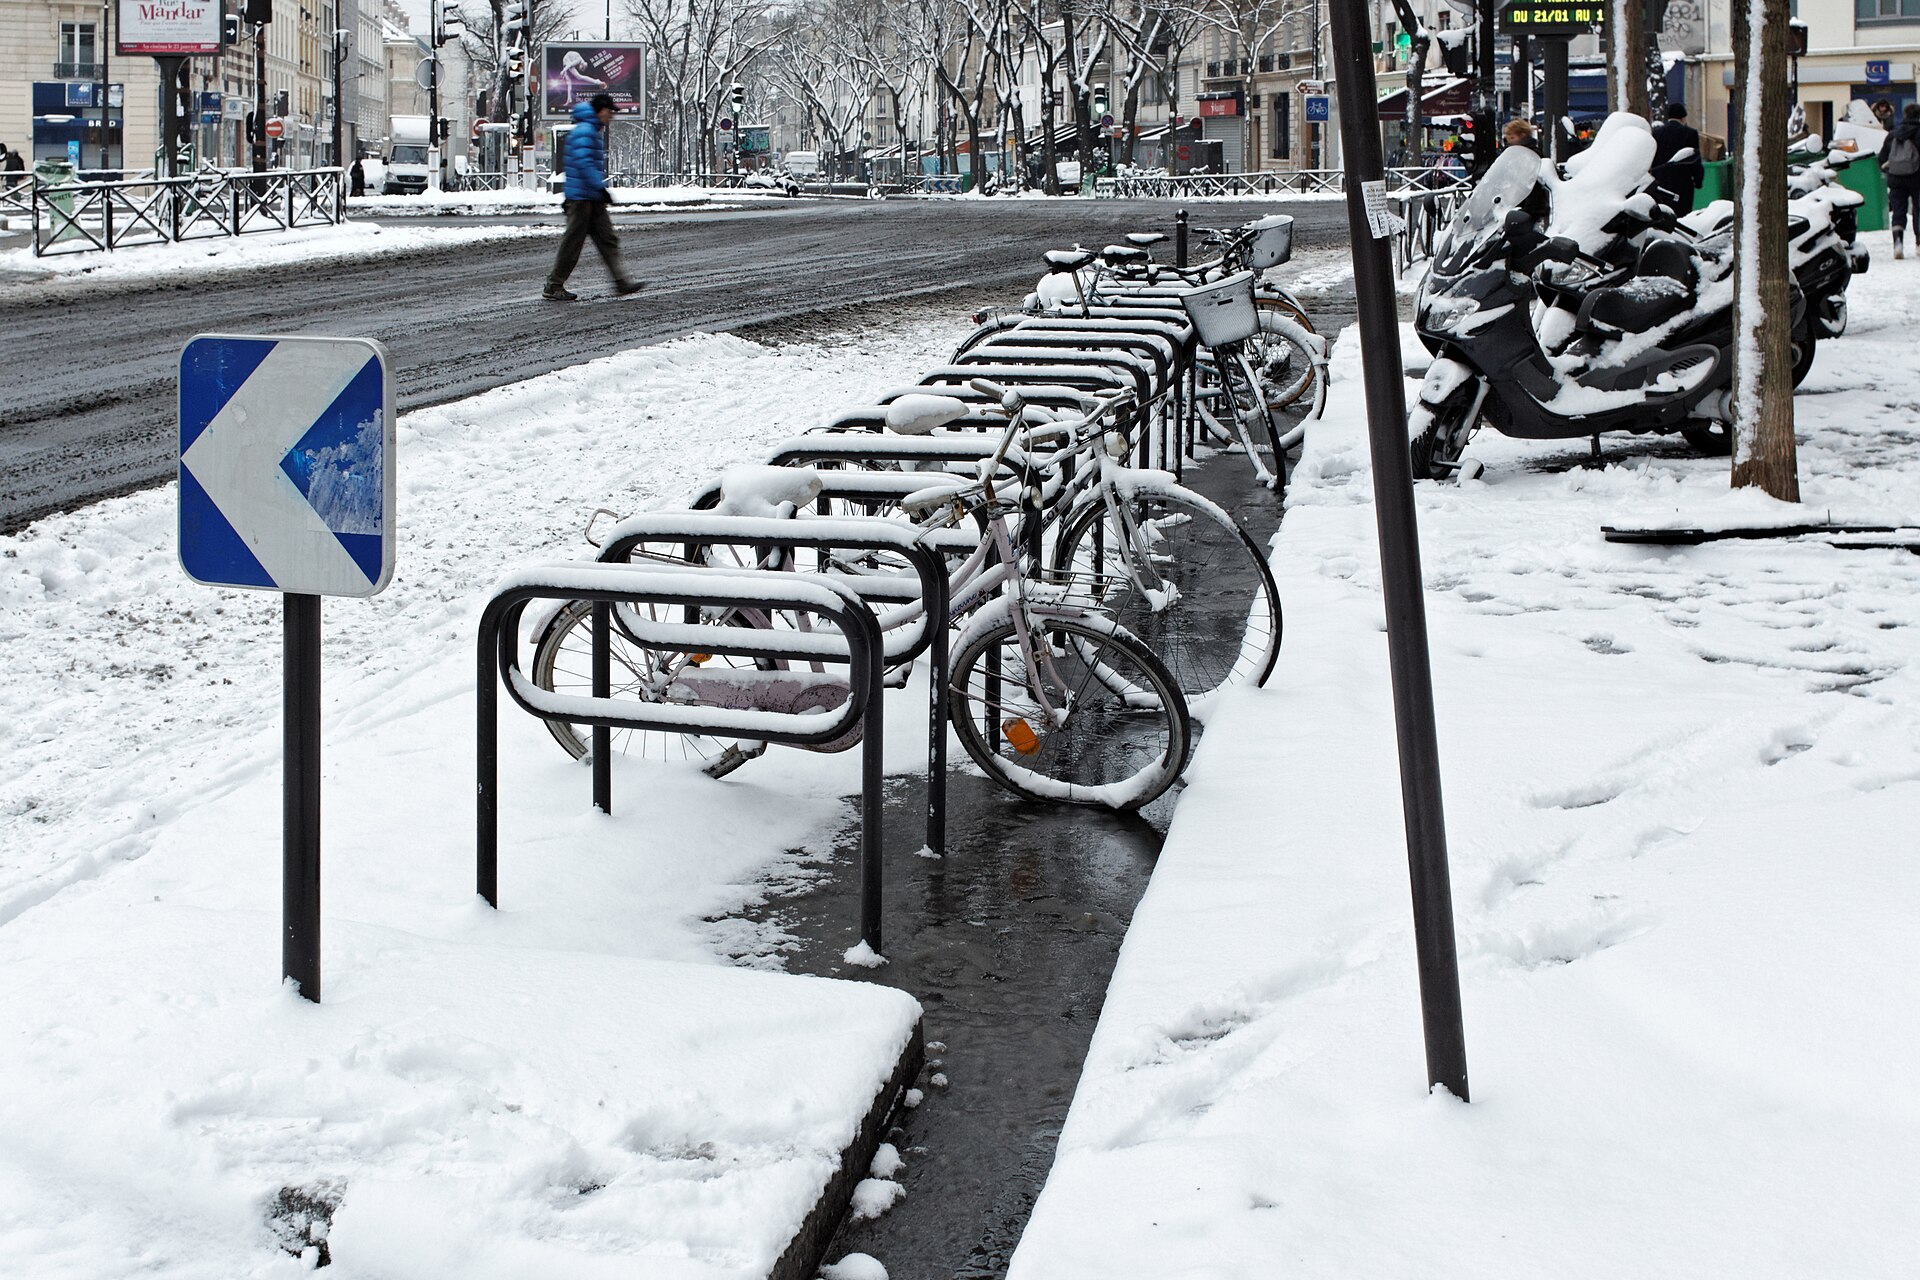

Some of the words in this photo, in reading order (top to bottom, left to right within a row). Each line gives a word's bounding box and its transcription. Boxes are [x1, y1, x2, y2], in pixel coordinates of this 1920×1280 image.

[138, 1, 205, 20] Mandar
[1513, 10, 1528, 22] DU
[1534, 10, 1569, 22] 21/01
[1575, 9, 1590, 22] AU
[1866, 64, 1886, 73] LCL
